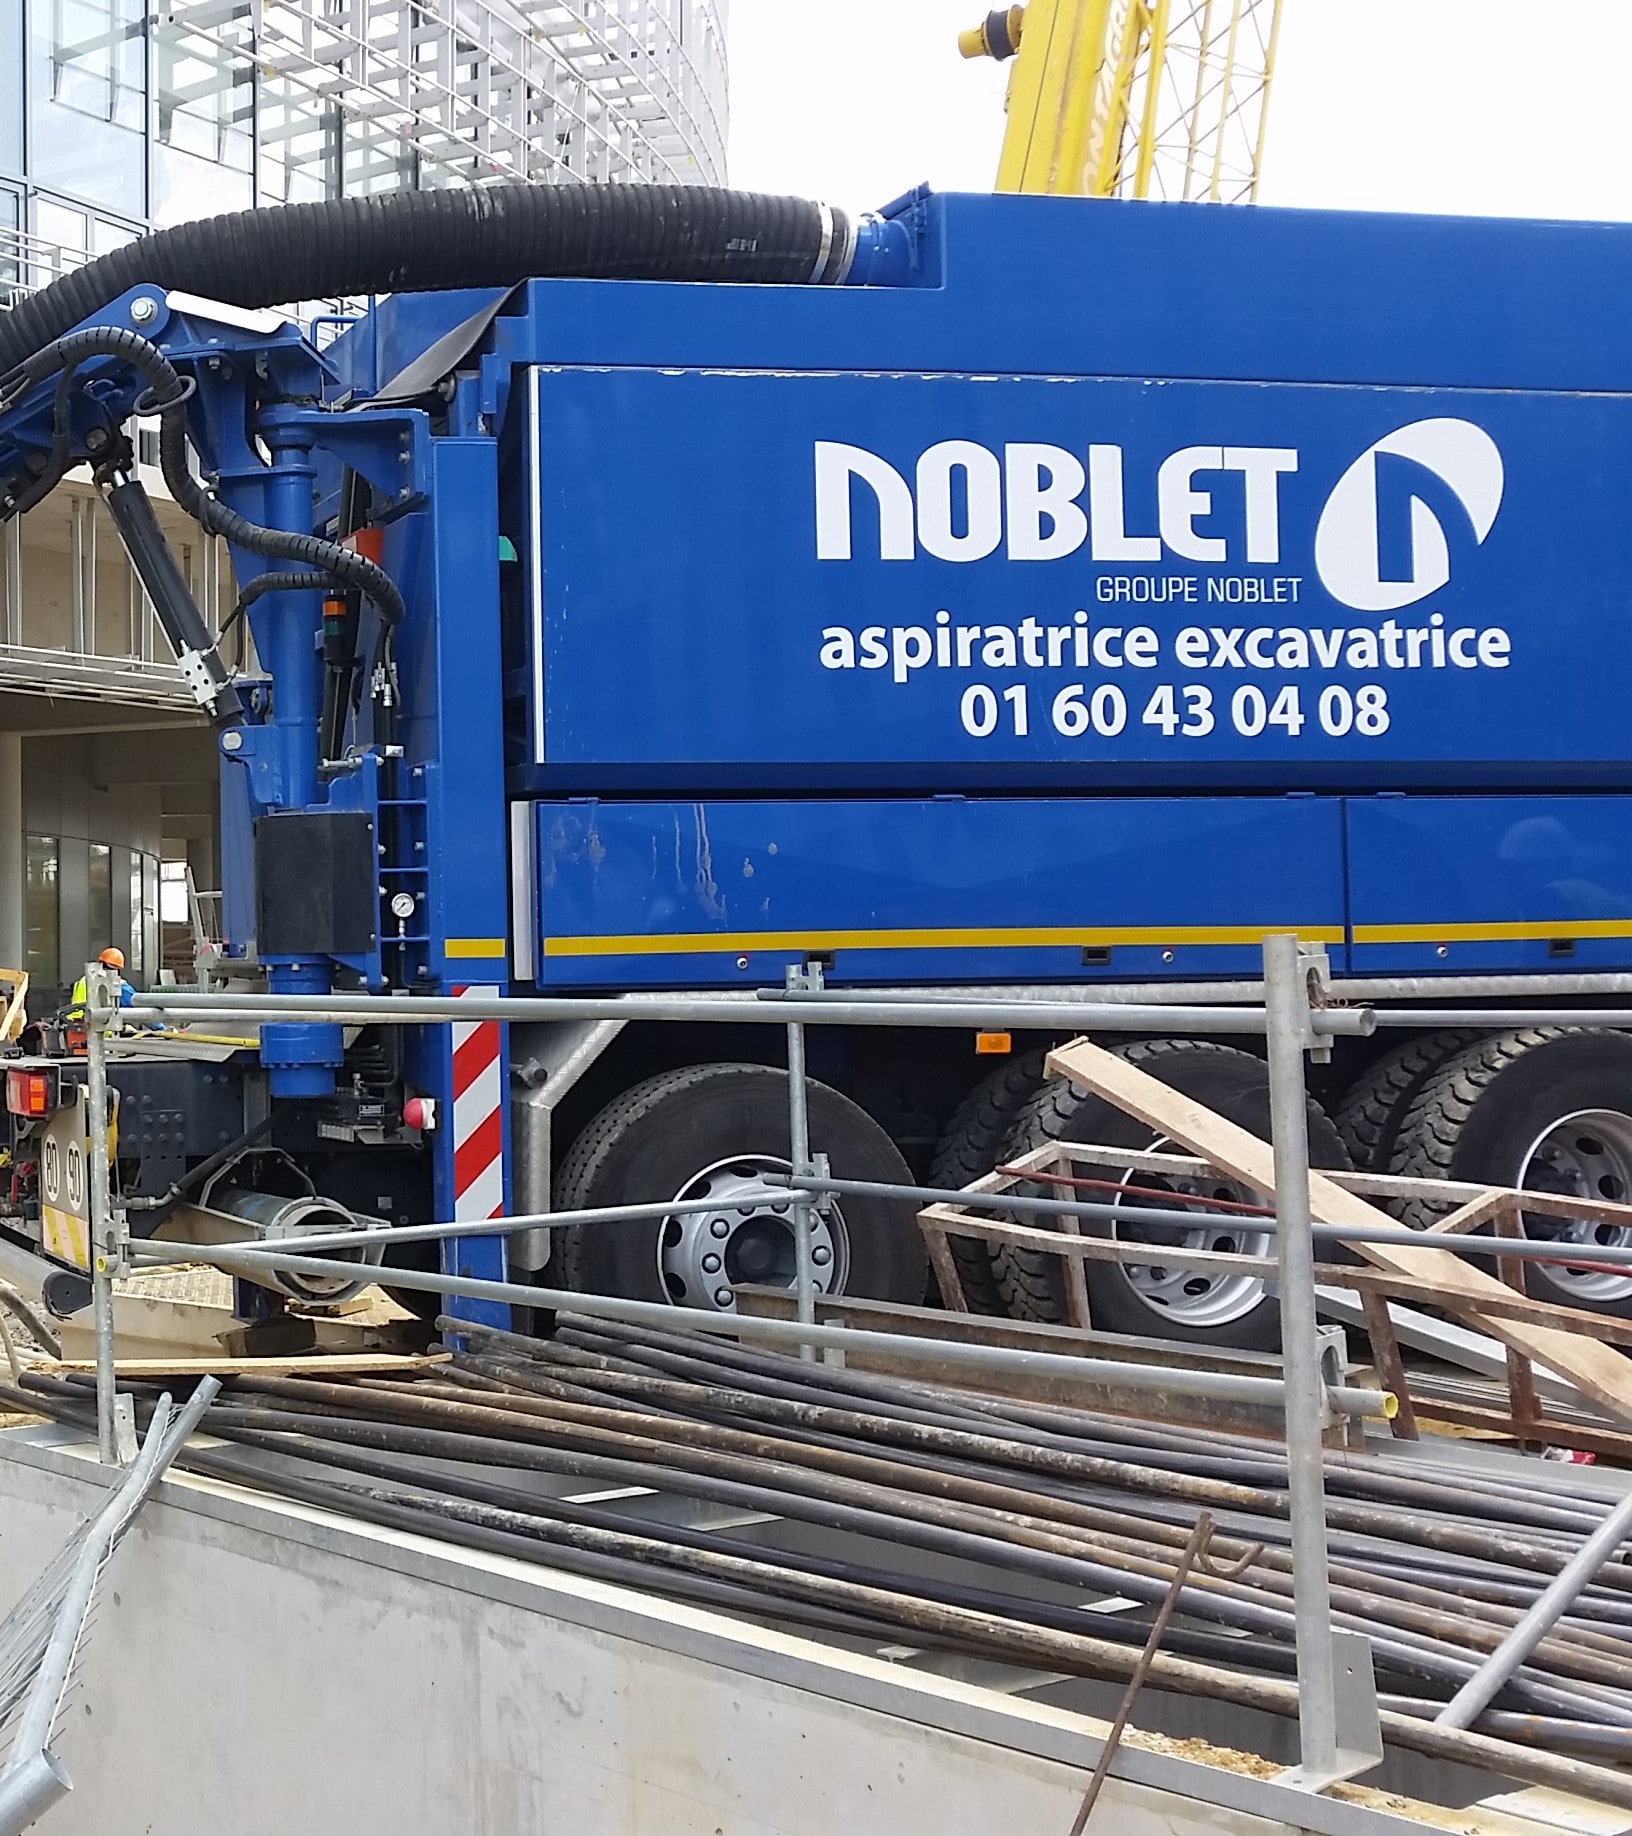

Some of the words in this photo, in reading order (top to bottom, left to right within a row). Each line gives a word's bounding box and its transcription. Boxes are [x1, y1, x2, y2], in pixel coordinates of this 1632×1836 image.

[1096, 576, 1198, 603] GROUPE
[1207, 577, 1303, 603] NOBLET
[819, 610, 1159, 683] aspiratrice
[1174, 612, 1511, 669] excavatrice
[960, 684, 1028, 737] 01
[1052, 684, 1127, 737] 60
[1142, 684, 1215, 737] 43
[1231, 684, 1305, 736] 04
[1318, 684, 1390, 737] 08
[46, 1141, 58, 1194] 80
[68, 1148, 81, 1203] 90
